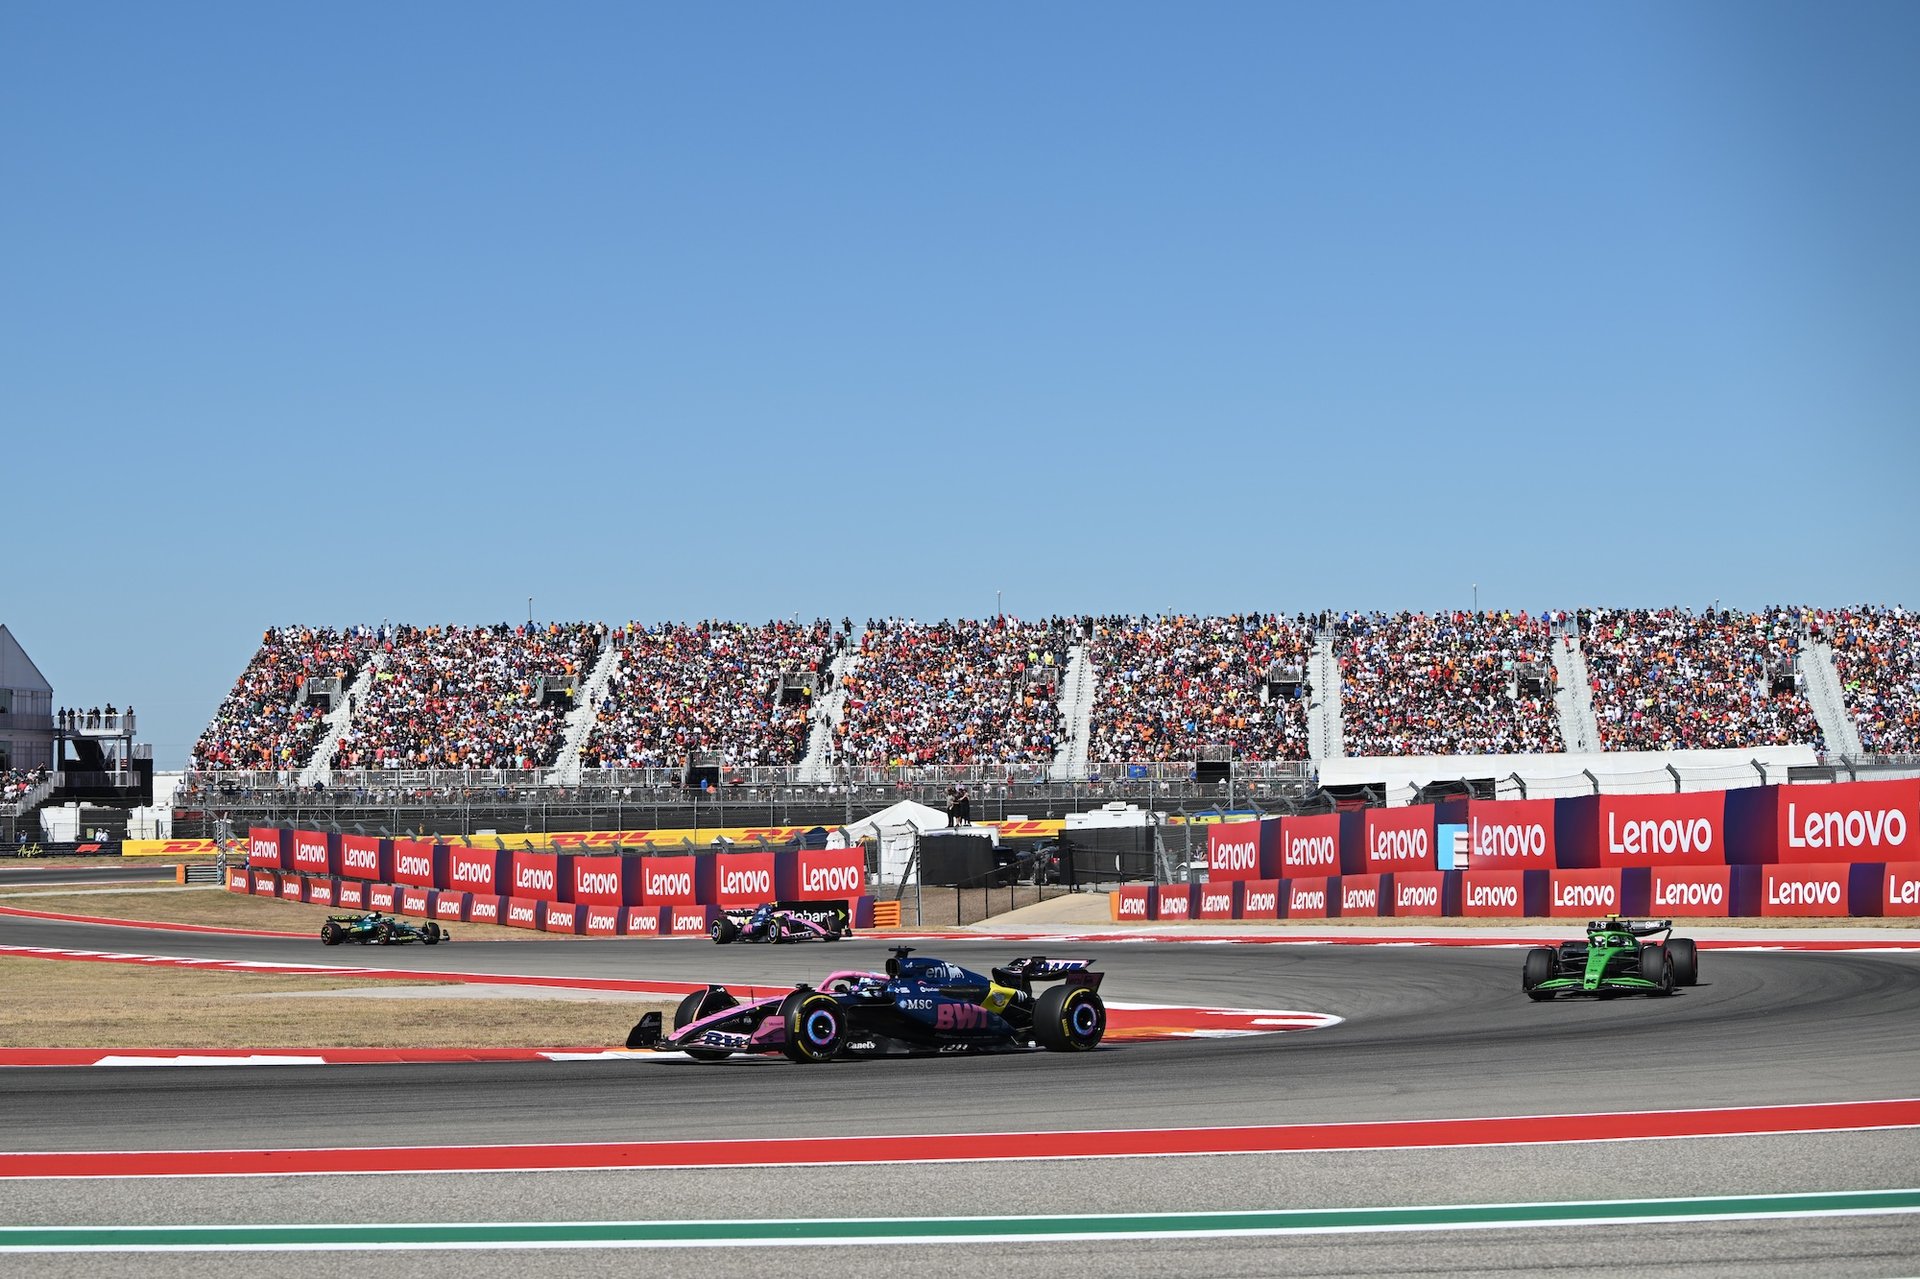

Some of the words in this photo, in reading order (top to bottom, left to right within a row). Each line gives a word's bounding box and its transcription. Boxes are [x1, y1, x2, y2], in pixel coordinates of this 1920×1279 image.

[1473, 816, 1545, 856] Lenovo
[1609, 812, 1711, 853] Lenovo
[1789, 803, 1906, 847] Lenovo
[250, 836, 277, 859] Lenovo
[296, 839, 325, 862] Lenovo
[547, 832, 657, 846] DHL
[1286, 831, 1334, 865] Lenovo
[1370, 824, 1427, 860] Lenovo
[345, 844, 376, 869] Lenovo
[397, 850, 429, 876] Lenovo
[1211, 837, 1256, 870] Lenovo
[453, 856, 491, 883] Lenovo
[517, 863, 553, 890] Lenovo
[578, 867, 617, 894] Lenovo
[721, 866, 769, 893] Lenovo
[803, 863, 859, 891] Lenovo
[646, 868, 690, 895] Lenovo
[1656, 879, 1722, 905] Lenovo
[1769, 877, 1840, 904] Lenovo
[341, 887, 360, 902] Lenovo
[371, 891, 391, 906] Lenovo
[404, 894, 425, 911] Lenovo
[1120, 894, 1145, 914] Lenovo
[1161, 895, 1187, 914] Lenovo
[1202, 892, 1230, 911] Lenovo
[1247, 890, 1275, 910] Lenovo
[1291, 888, 1324, 909] Lenovo
[1343, 886, 1375, 908] Lenovo
[1398, 883, 1437, 906] Lenovo
[1467, 882, 1517, 906] Lenovo
[1554, 881, 1614, 906] Lenovo
[438, 898, 459, 914] Lenovo
[472, 901, 496, 917] Lenovo
[510, 904, 533, 921] Lenovo
[548, 909, 572, 926] Lenovo
[589, 912, 614, 929] Lenovo
[630, 914, 656, 930] Lenovo
[674, 913, 703, 930] Lenovo
[926, 962, 946, 978] eni
[907, 999, 933, 1010] MSC
[846, 1040, 876, 1050] Canel's
